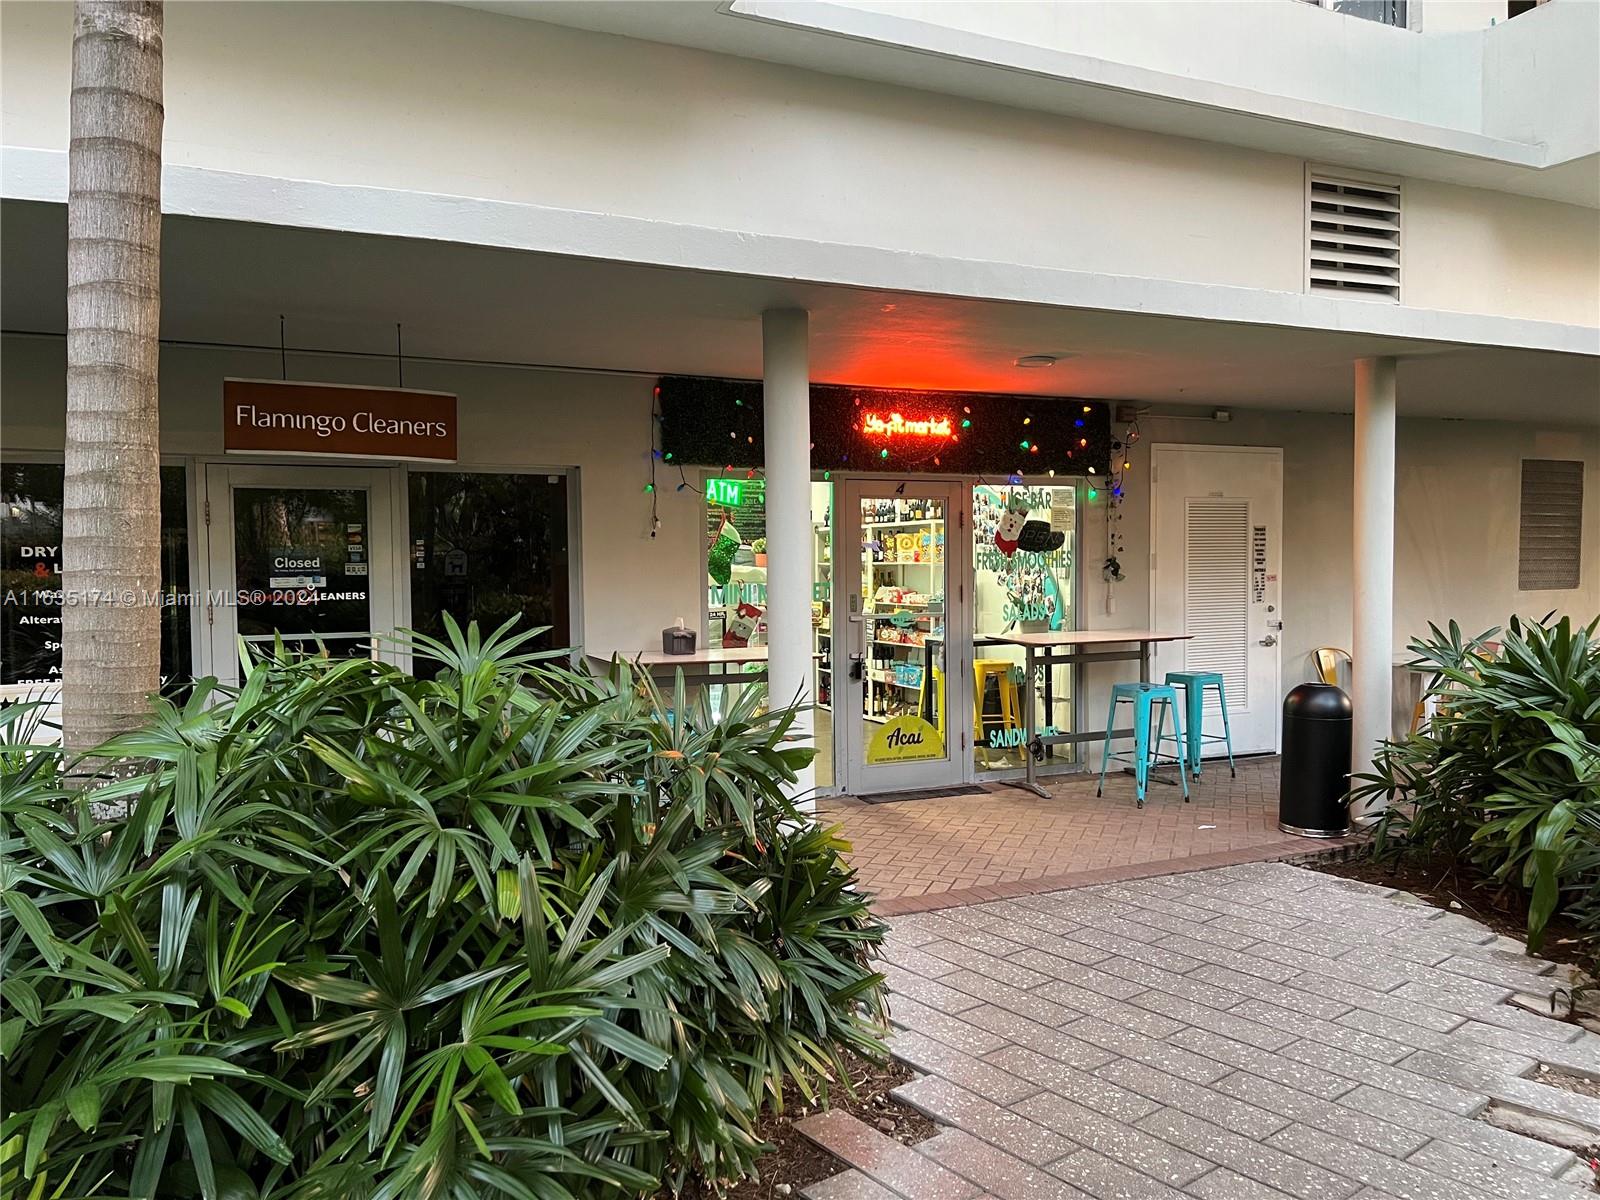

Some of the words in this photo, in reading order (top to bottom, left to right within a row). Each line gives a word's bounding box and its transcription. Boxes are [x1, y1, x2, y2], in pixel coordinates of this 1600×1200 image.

[236, 404, 346, 437] Flamingo
[352, 412, 447, 437] Cleaners
[706, 478, 740, 505] ATM
[896, 483, 905, 495] 4
[1030, 491, 1052, 510] BAR
[20, 546, 59, 557] DRY
[976, 552, 1007, 571] FRESH
[1011, 550, 1072, 571] SMOOTHIES
[274, 557, 320, 568] Closed
[711, 583, 752, 605] MINI
[1002, 602, 1047, 622] SALADS
